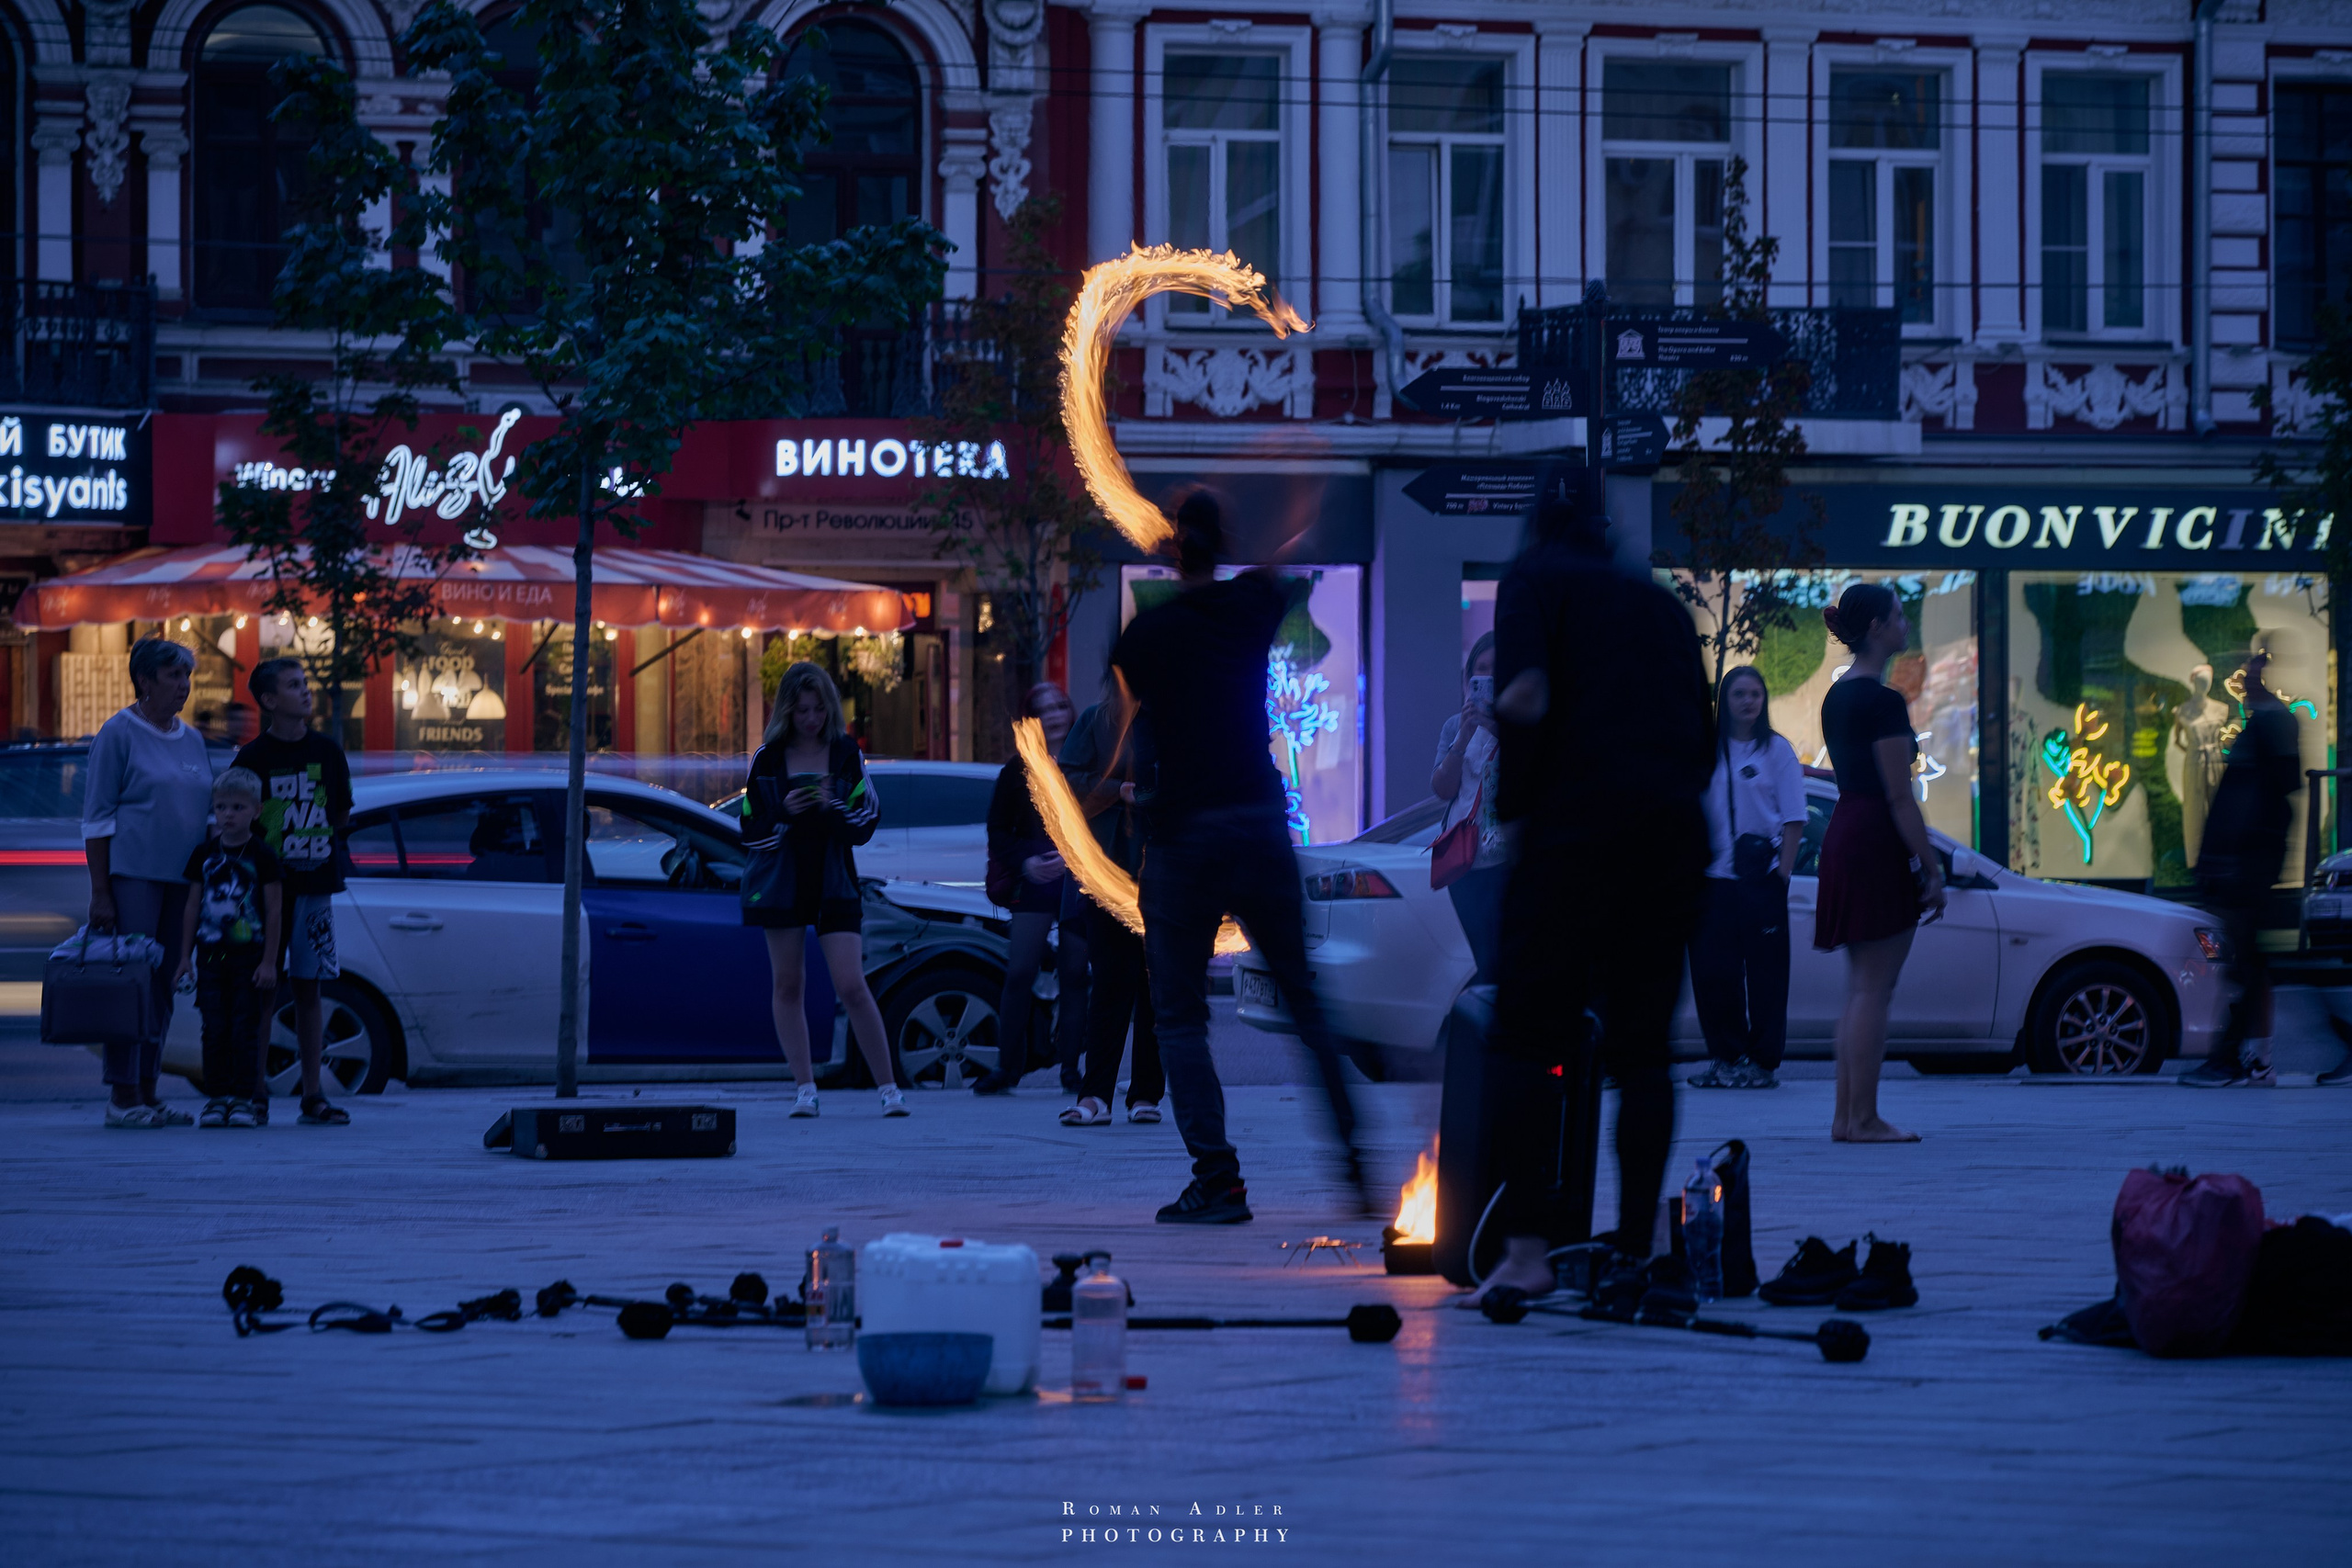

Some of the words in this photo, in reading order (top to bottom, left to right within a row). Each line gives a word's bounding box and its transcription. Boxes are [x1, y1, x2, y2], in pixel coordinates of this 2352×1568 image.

[48, 423, 127, 461] БУТИК
[775, 438, 1010, 480] ВИНОТЕКА
[763, 509, 810, 533] Пр-т
[1882, 502, 2335, 550] BUONVICINI
[441, 582, 494, 602] ВИНО
[498, 584, 513, 602] И
[515, 584, 553, 606] ЕДА
[428, 655, 475, 671] FOOD
[418, 726, 484, 741] FRIENDS
